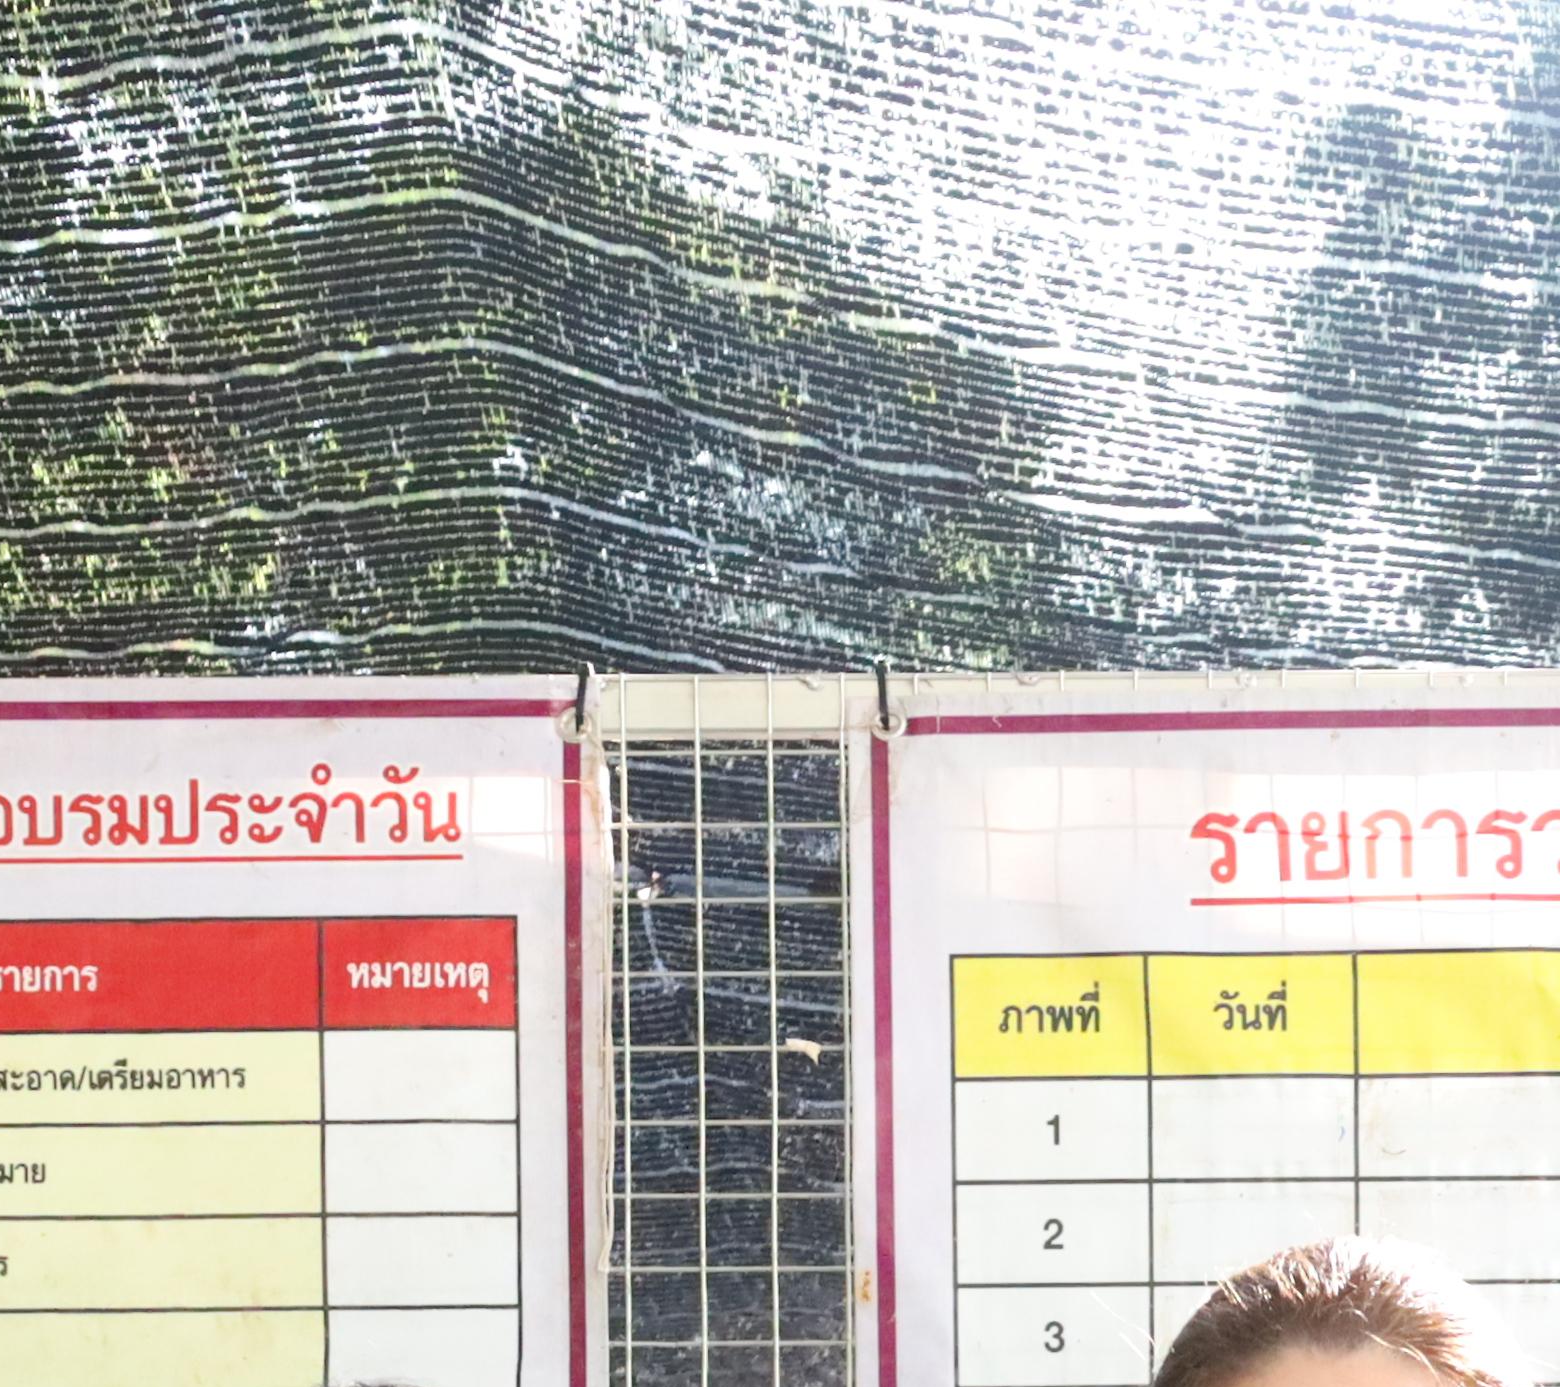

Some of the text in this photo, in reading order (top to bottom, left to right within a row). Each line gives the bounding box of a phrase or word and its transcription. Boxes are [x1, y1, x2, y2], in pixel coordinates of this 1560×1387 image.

[346, 961, 491, 1004] หมายเหตุ
[998, 981, 1101, 1034] ภาพที่
[1213, 979, 1288, 1032] วันที่
[1046, 1114, 1060, 1146] 1
[1043, 1218, 1064, 1250] 2
[1044, 1320, 1065, 1354] 3
